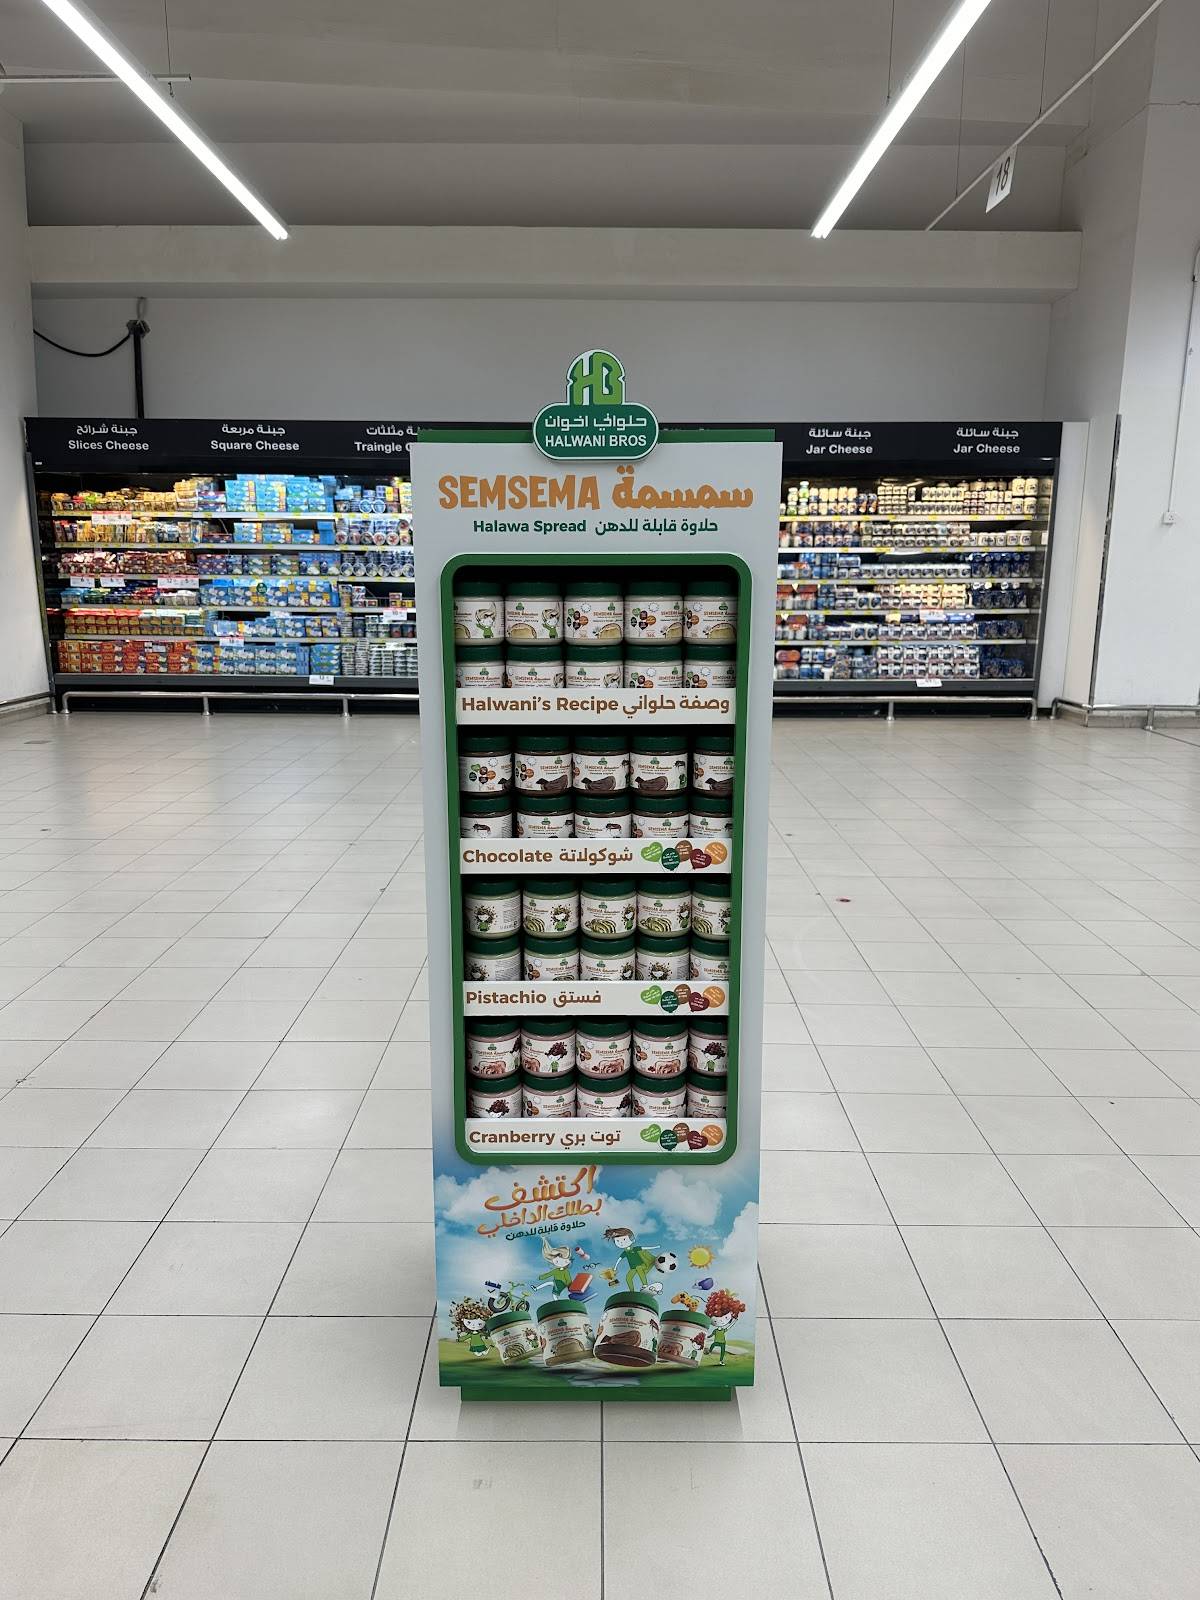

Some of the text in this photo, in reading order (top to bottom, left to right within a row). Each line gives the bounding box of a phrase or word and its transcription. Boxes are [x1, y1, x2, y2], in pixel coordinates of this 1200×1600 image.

[996, 156, 1011, 196] 18
[76, 423, 138, 436] جبنة شرائح
[221, 424, 286, 436] جبنة مربعة
[593, 413, 647, 431] حلواني
[366, 425, 404, 436] مثلثات
[808, 427, 872, 439] جبنة سائلة
[956, 427, 1019, 439] جبنة سائلة
[68, 440, 149, 450] Slices Cheese
[210, 440, 300, 452] Square Cheese
[354, 441, 402, 454] Traingle
[545, 435, 647, 447] HALWANI BROS
[806, 444, 873, 454] Jar Cheese
[953, 443, 1020, 454] Jar Cheese
[438, 474, 600, 510] SEMSEMA
[612, 465, 754, 509] سمسمة
[473, 520, 587, 536] Halawa Spread
[594, 518, 719, 536] حلاوة قابلة للدهن
[462, 695, 619, 714] Halwani's Recipe
[622, 694, 730, 719] وصفة حلواني
[462, 848, 553, 863] Chocolate
[559, 846, 633, 866] شوكولاتة
[466, 990, 547, 1004] Pistachio
[553, 990, 601, 1008] فستق
[469, 1130, 555, 1145] Cranberry
[560, 1132, 586, 1150] بري
[590, 1130, 621, 1146] توت
[484, 1165, 597, 1211] اكتشف
[476, 1204, 548, 1238] الداخلي
[505, 1220, 586, 1241] حلاوة قابلة للدهن
